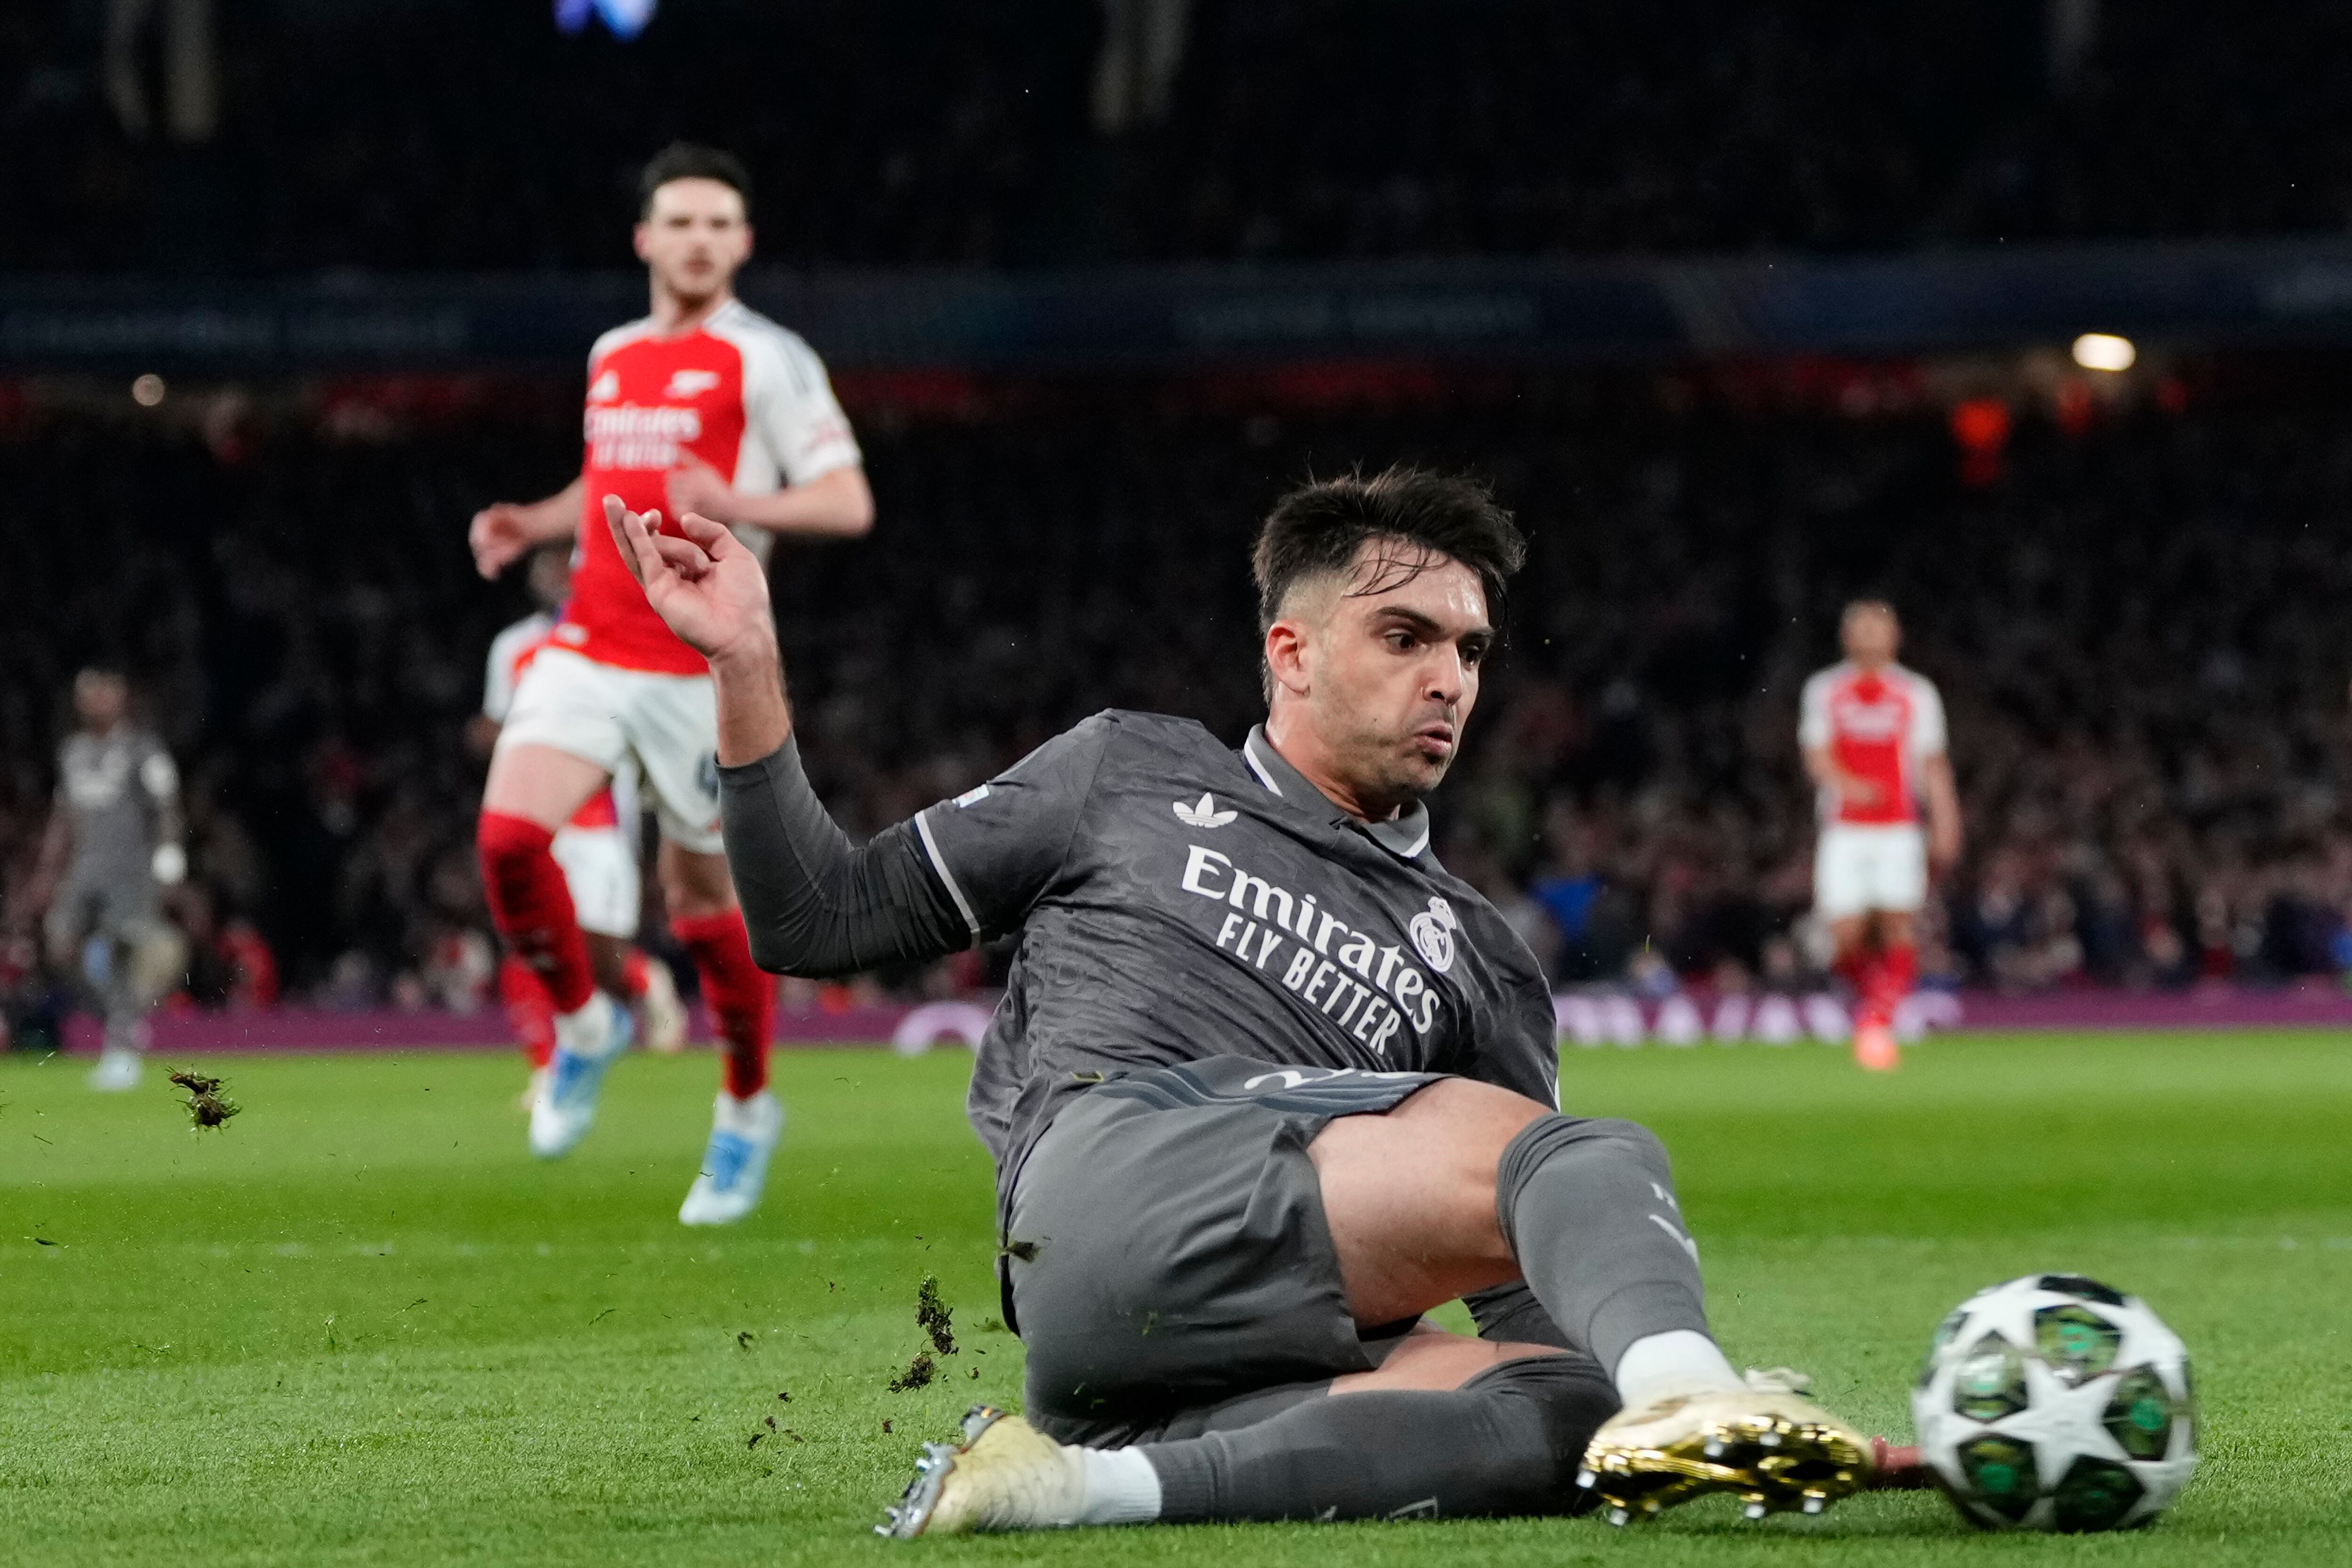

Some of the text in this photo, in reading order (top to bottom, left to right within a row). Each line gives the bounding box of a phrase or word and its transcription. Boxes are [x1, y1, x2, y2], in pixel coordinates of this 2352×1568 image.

[1182, 844, 1440, 1034] Emirates
[1216, 912, 1400, 1055] FLY BETTER
